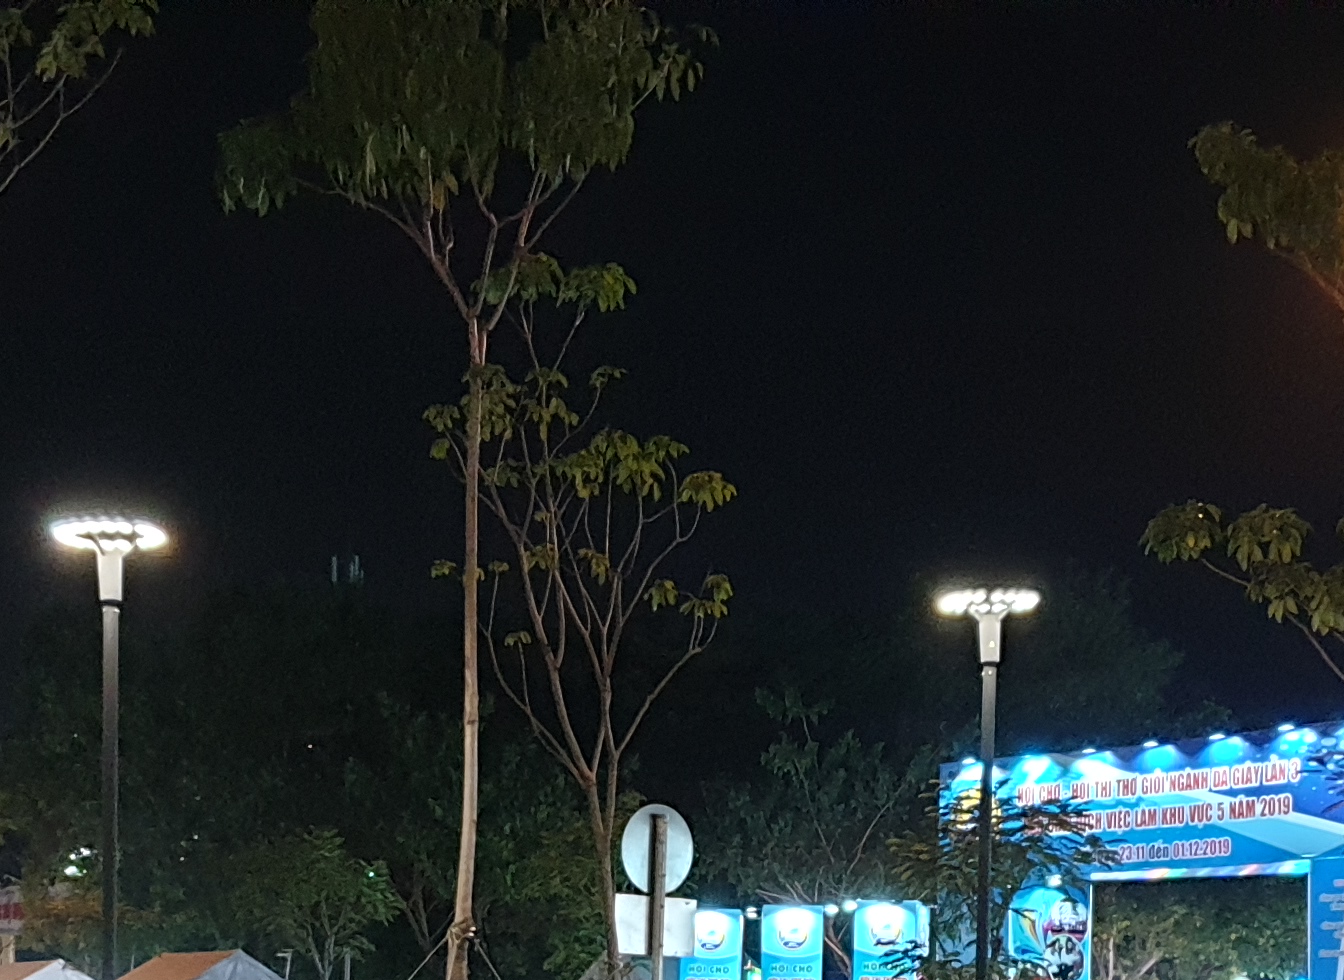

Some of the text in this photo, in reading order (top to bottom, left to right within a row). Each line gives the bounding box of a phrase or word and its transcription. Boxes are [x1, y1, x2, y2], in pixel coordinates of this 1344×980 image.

[1291, 761, 1299, 780] 3
[1161, 804, 1185, 825] KHU
[1217, 802, 1225, 821] 5
[1259, 796, 1291, 817] 2019
